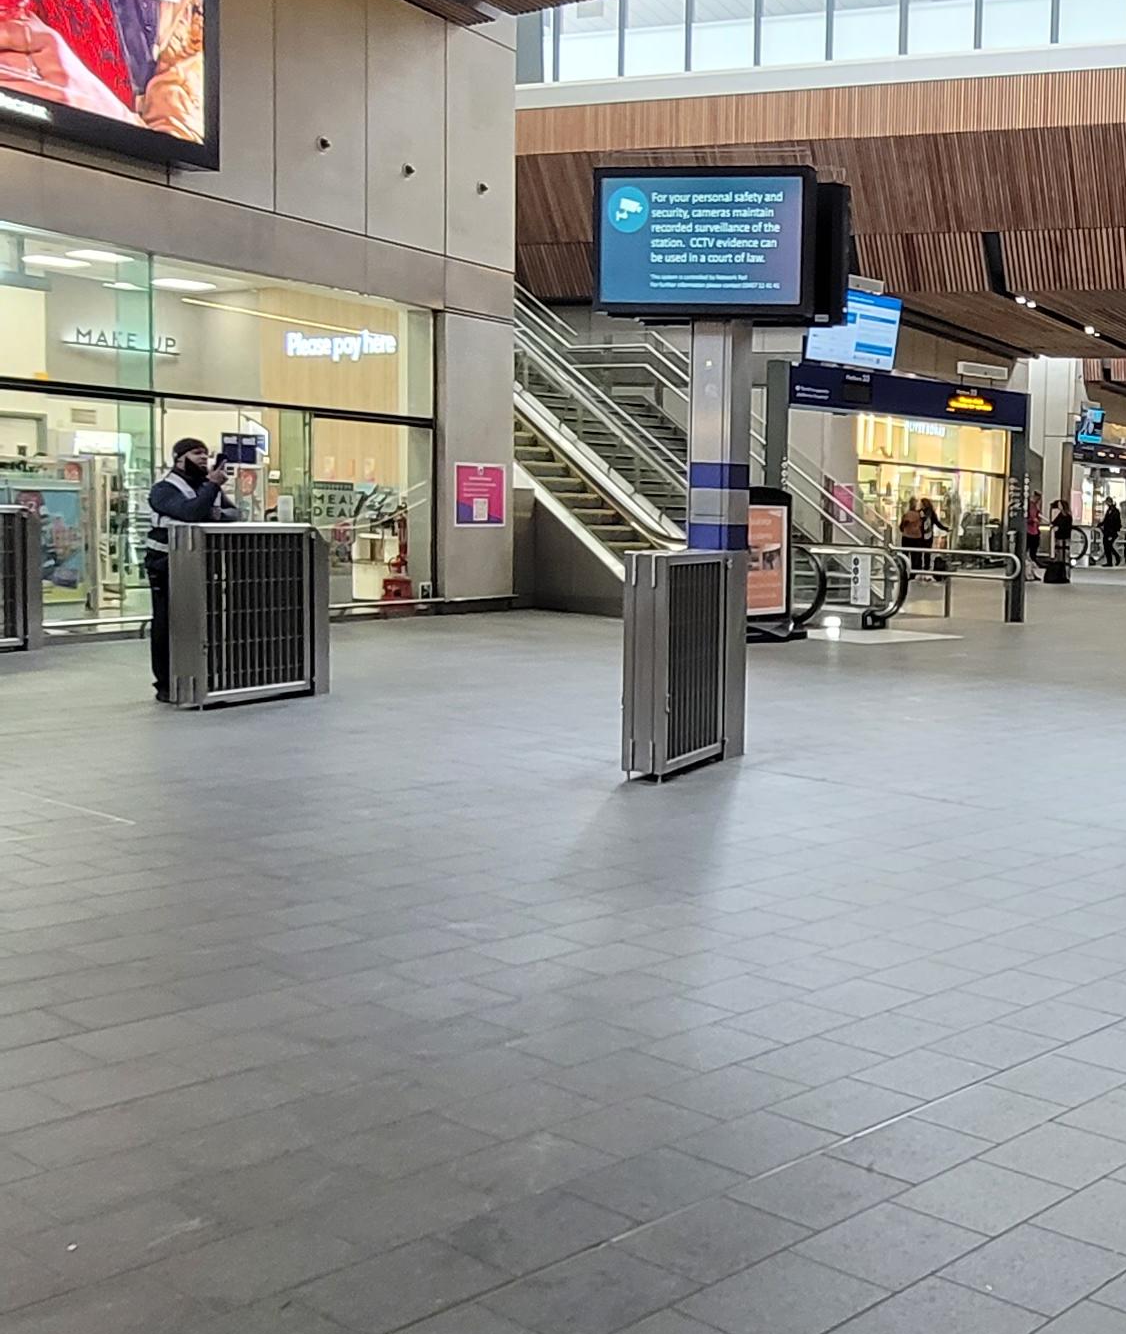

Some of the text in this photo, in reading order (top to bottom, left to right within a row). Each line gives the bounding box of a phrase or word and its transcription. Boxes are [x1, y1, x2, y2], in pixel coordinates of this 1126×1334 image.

[651, 191, 784, 204] For your personal safety and
[691, 208, 731, 218] cameras
[732, 207, 775, 218] maintain
[651, 222, 780, 233] recorded surveillance of the
[689, 237, 715, 248] CCTV
[716, 238, 759, 248] evidence
[760, 239, 778, 248] can
[650, 252, 663, 263] be
[664, 252, 687, 263] used
[688, 252, 698, 263] in
[707, 253, 733, 263] court
[734, 252, 745, 263] of
[75, 327, 137, 349] MAKE
[286, 329, 398, 362] Please pay here
[313, 493, 354, 505] MEAL
